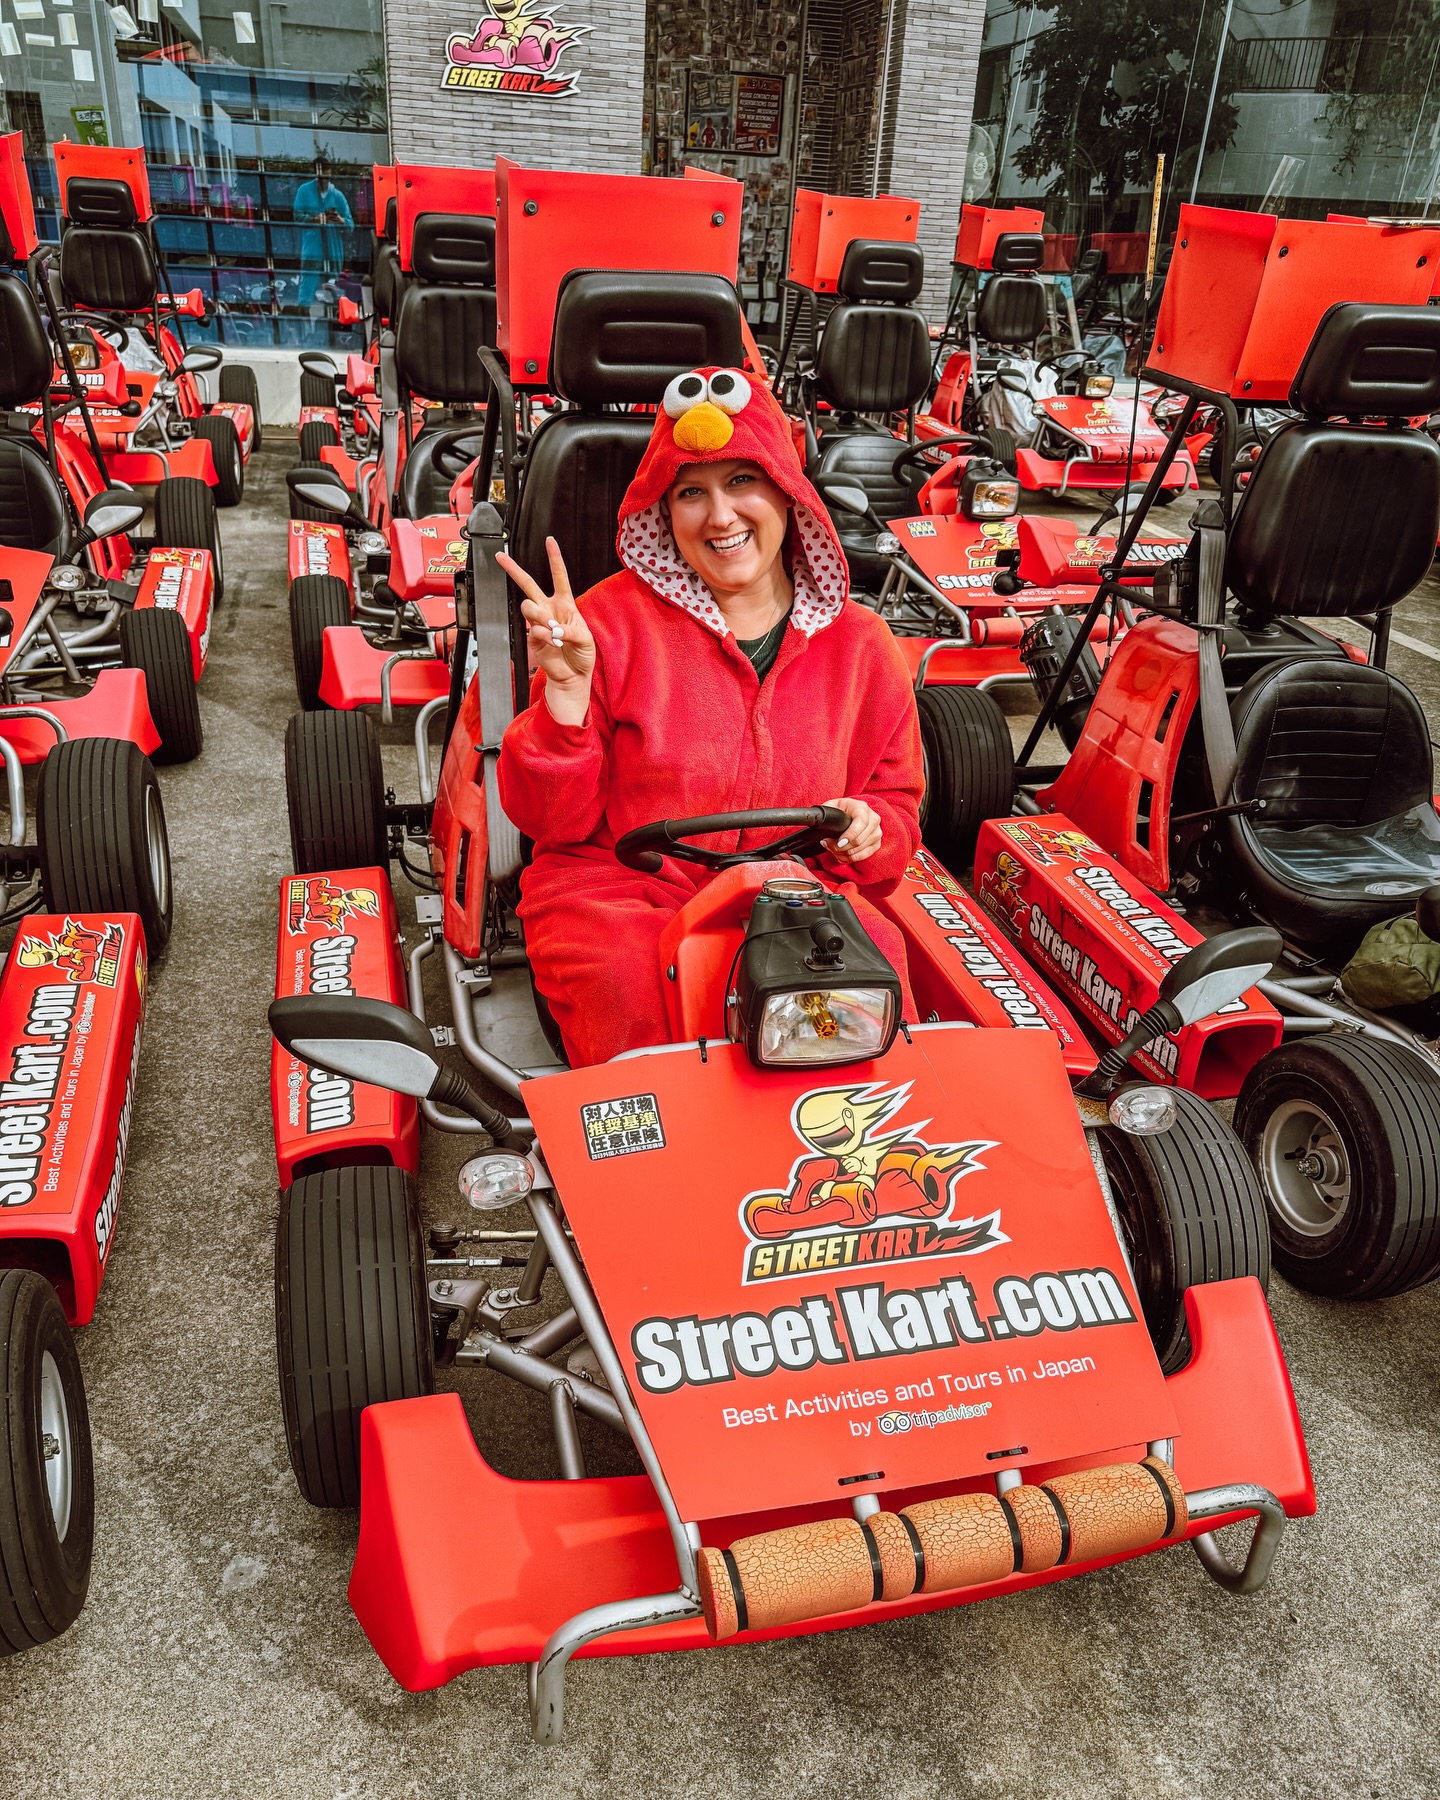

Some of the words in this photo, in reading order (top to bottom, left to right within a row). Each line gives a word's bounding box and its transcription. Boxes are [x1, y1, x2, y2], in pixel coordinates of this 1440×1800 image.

[1075, 867, 1154, 918] Street
[1030, 904, 1082, 979] Street
[1080, 956, 1122, 1024] Kart
[74, 1035, 88, 1044] by
[69, 1046, 85, 1068] Japan
[67, 1069, 80, 1077] in
[61, 1078, 78, 1102] Tours
[60, 1104, 73, 1118] and
[585, 1097, 654, 1121] 対人対物
[587, 1111, 658, 1138] 推奨基準
[48, 1121, 70, 1165] Activities
[591, 1127, 660, 1153] 任意保険
[43, 1167, 60, 1192] Best
[753, 1226, 931, 1277] STREETKART
[635, 1299, 844, 1389] Street
[722, 1403, 778, 1428] Best
[785, 1388, 889, 1419] Activities
[895, 1377, 935, 1402] and
[938, 1371, 1003, 1395] Tours
[1006, 1364, 1028, 1383] in
[1032, 1356, 1097, 1380] Japan
[849, 1419, 872, 1438] by
